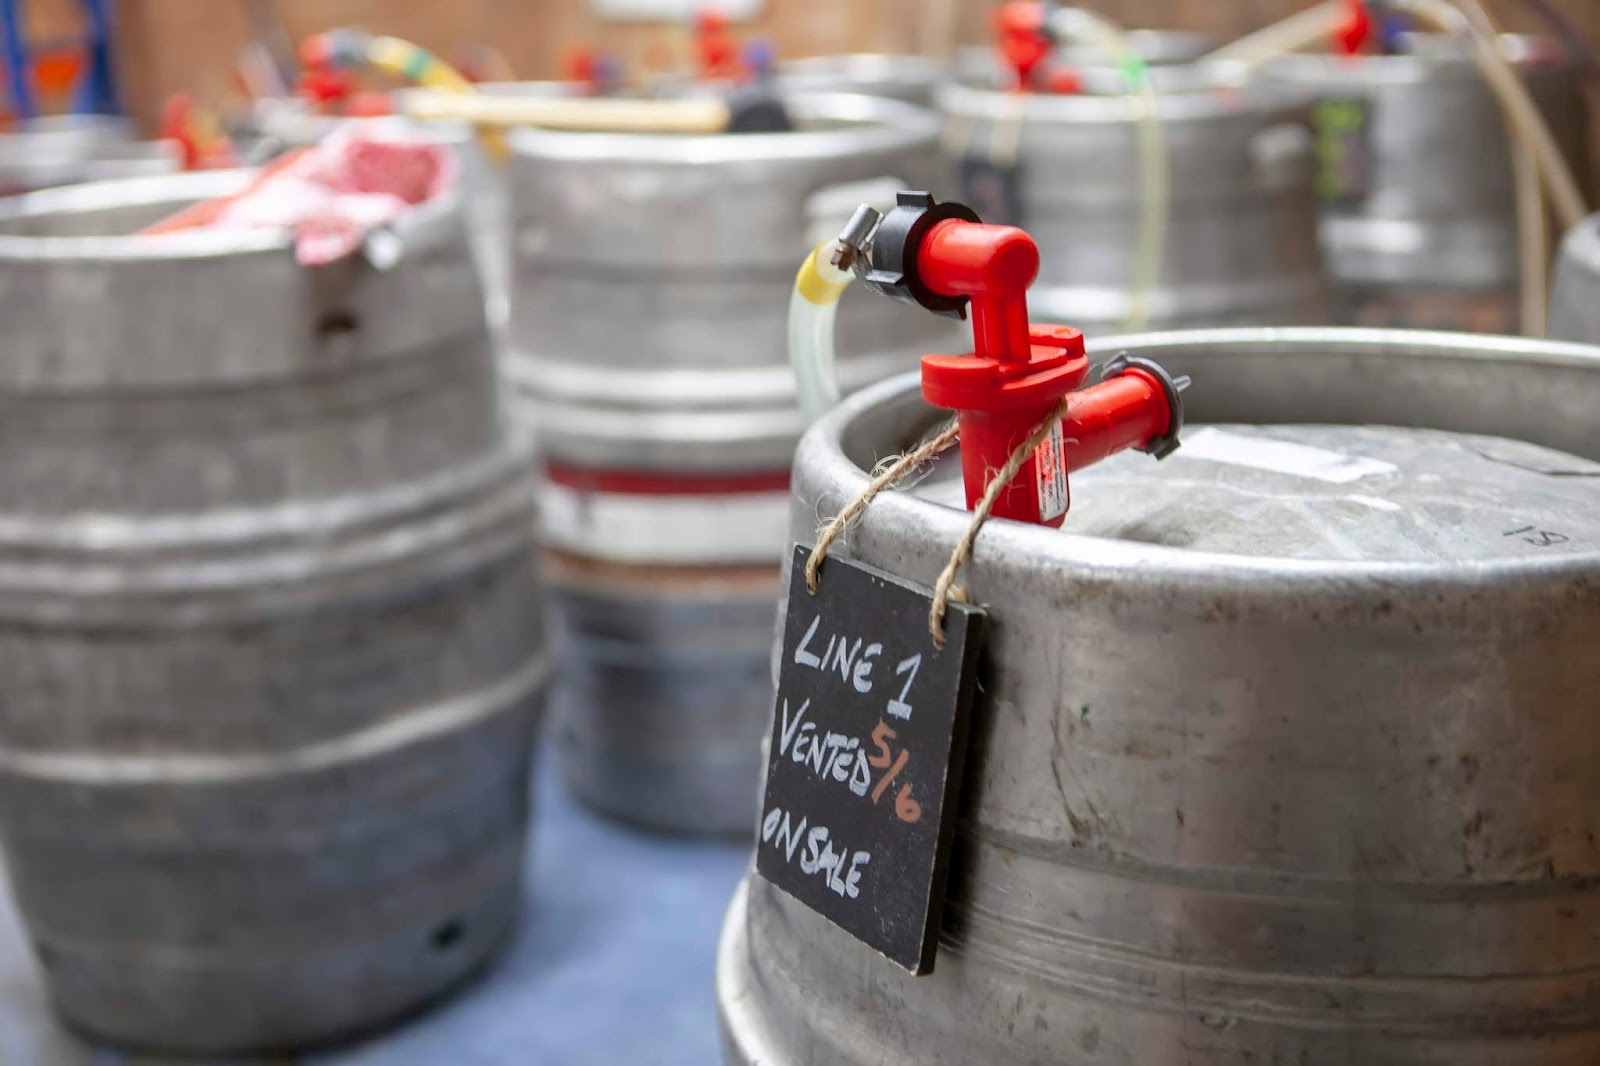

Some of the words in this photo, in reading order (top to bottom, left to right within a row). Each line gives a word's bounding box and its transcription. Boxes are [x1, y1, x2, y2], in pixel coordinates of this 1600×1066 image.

[795, 615, 882, 693] LINE
[887, 653, 922, 721] 1
[780, 698, 871, 797] VENTED
[869, 717, 922, 824] 5/6
